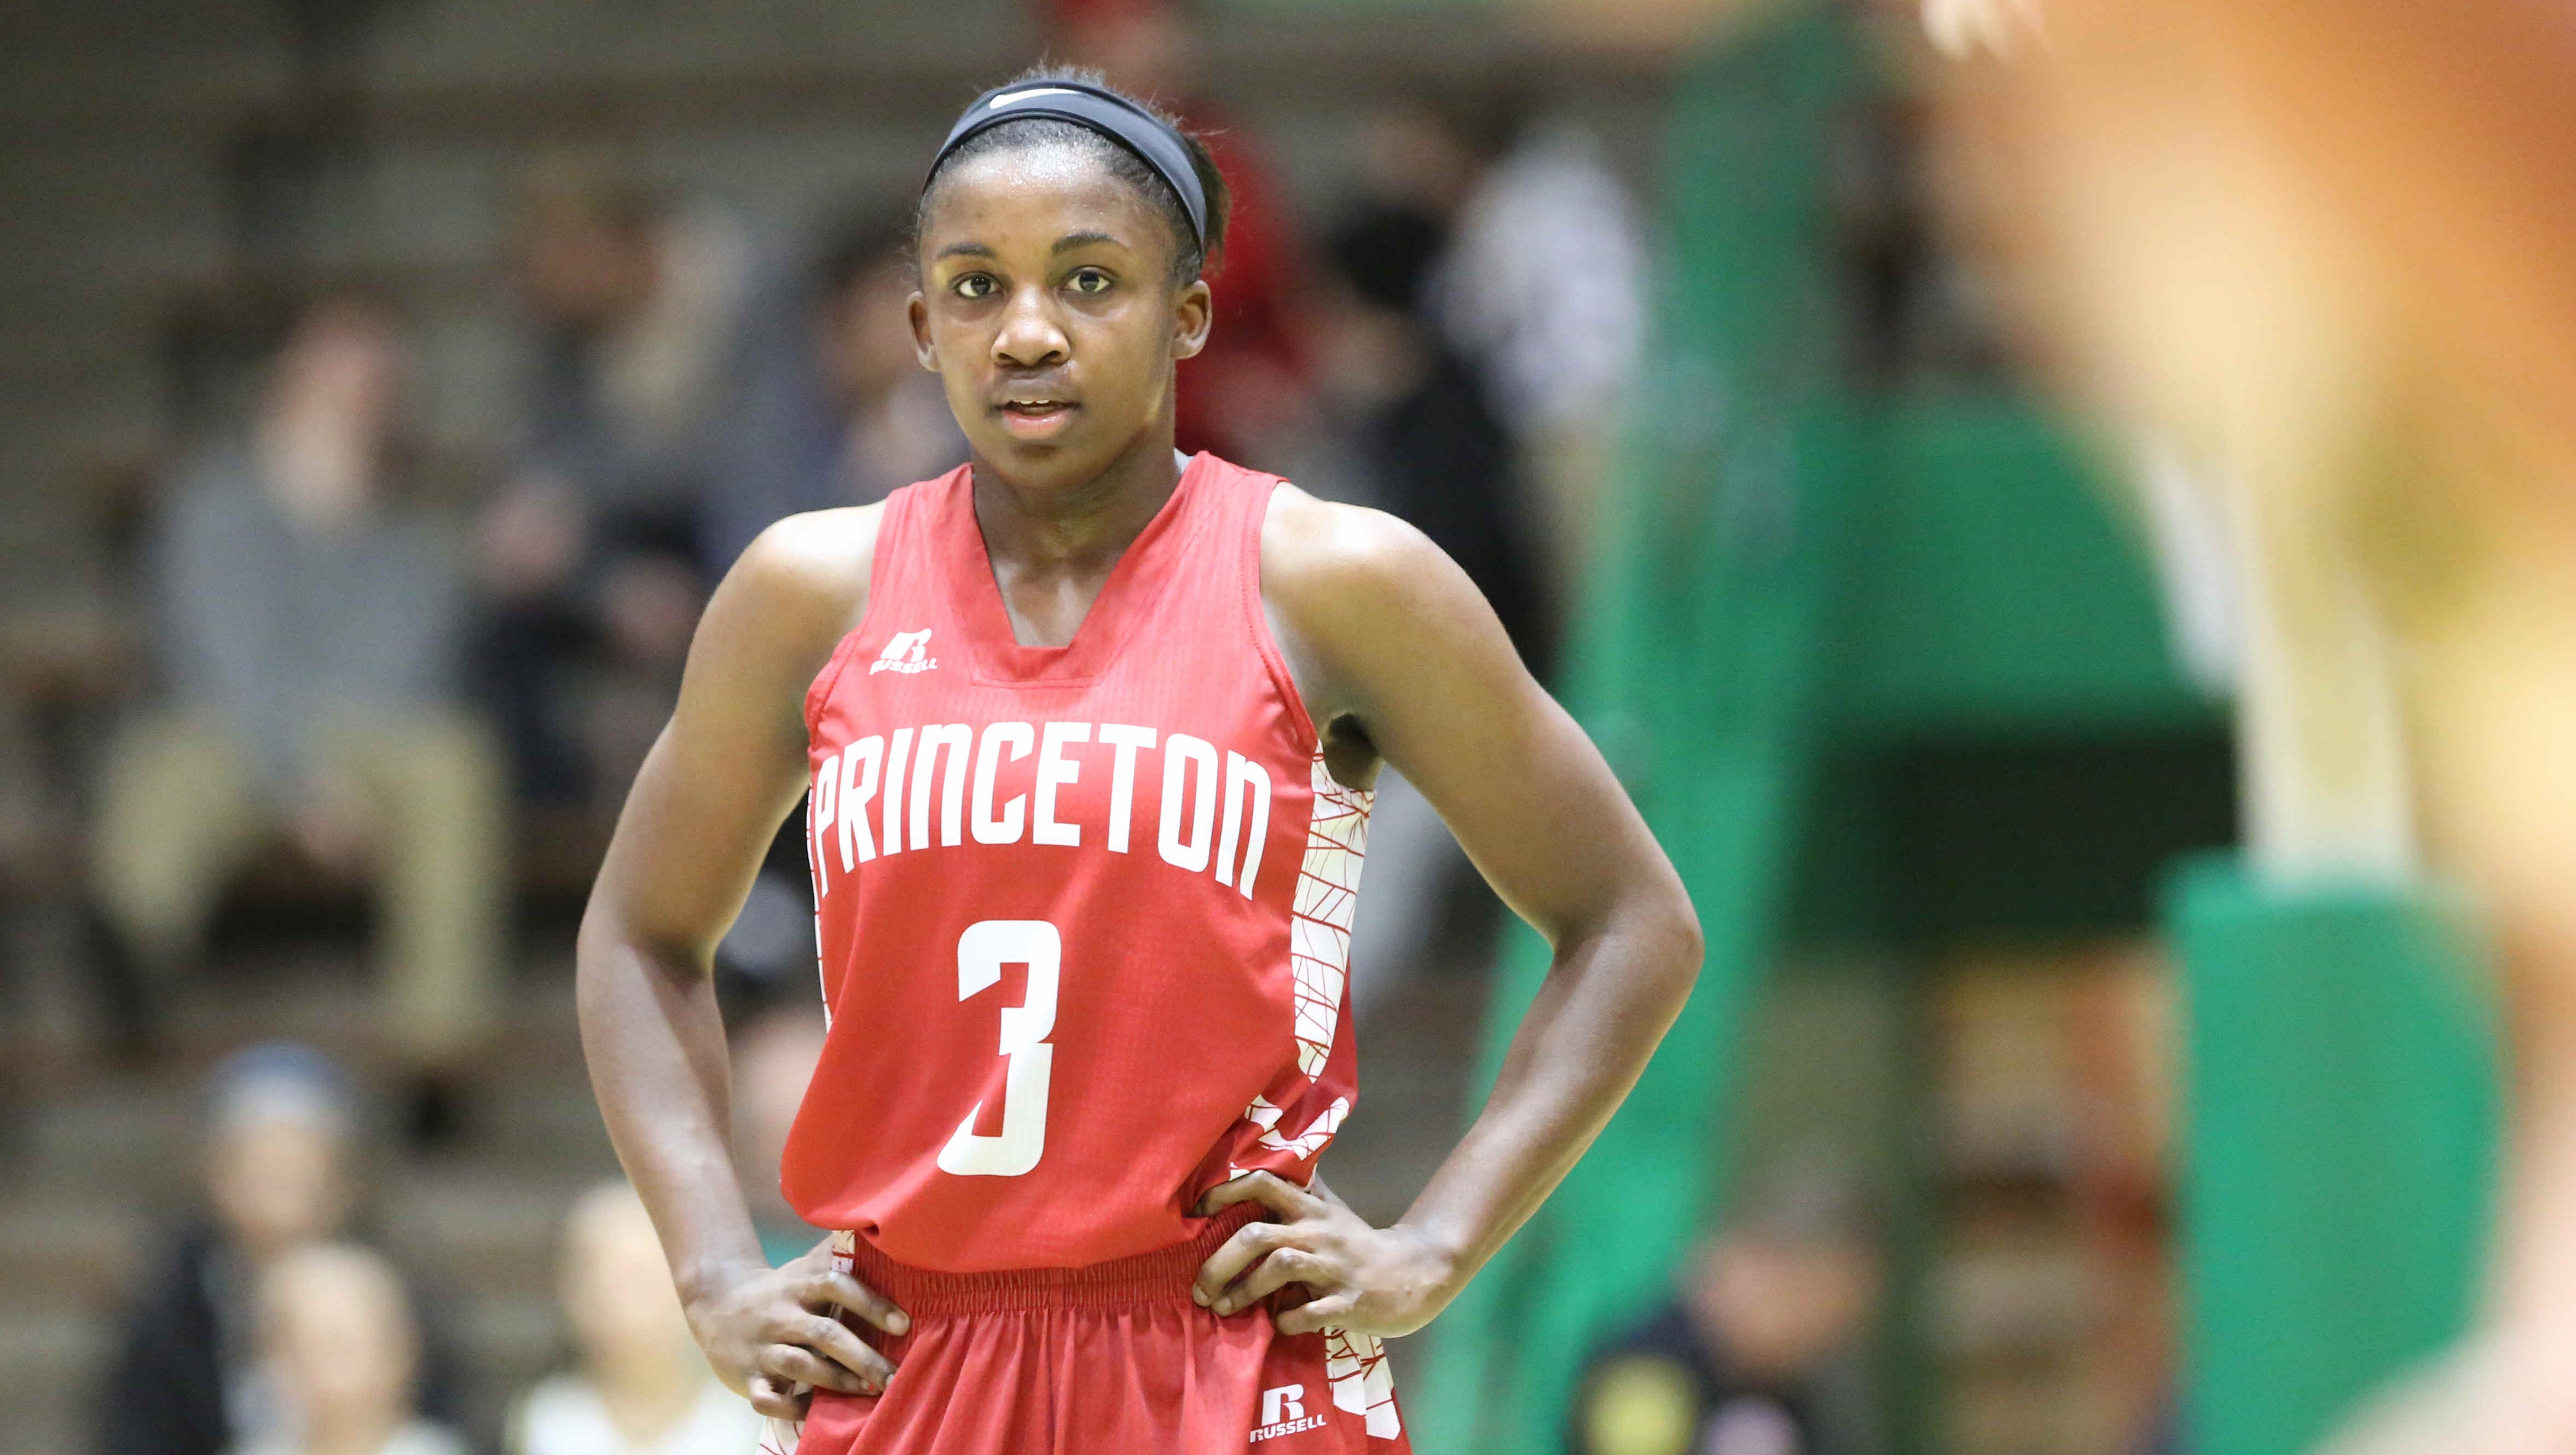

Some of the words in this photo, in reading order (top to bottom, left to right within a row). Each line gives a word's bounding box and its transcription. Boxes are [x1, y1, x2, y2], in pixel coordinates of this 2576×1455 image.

[869, 658, 937, 675] RUSSELL
[815, 722, 1272, 901] PRINCETON
[936, 920, 1061, 1176] 3
[1249, 1414, 1327, 1443] RUSSELL
